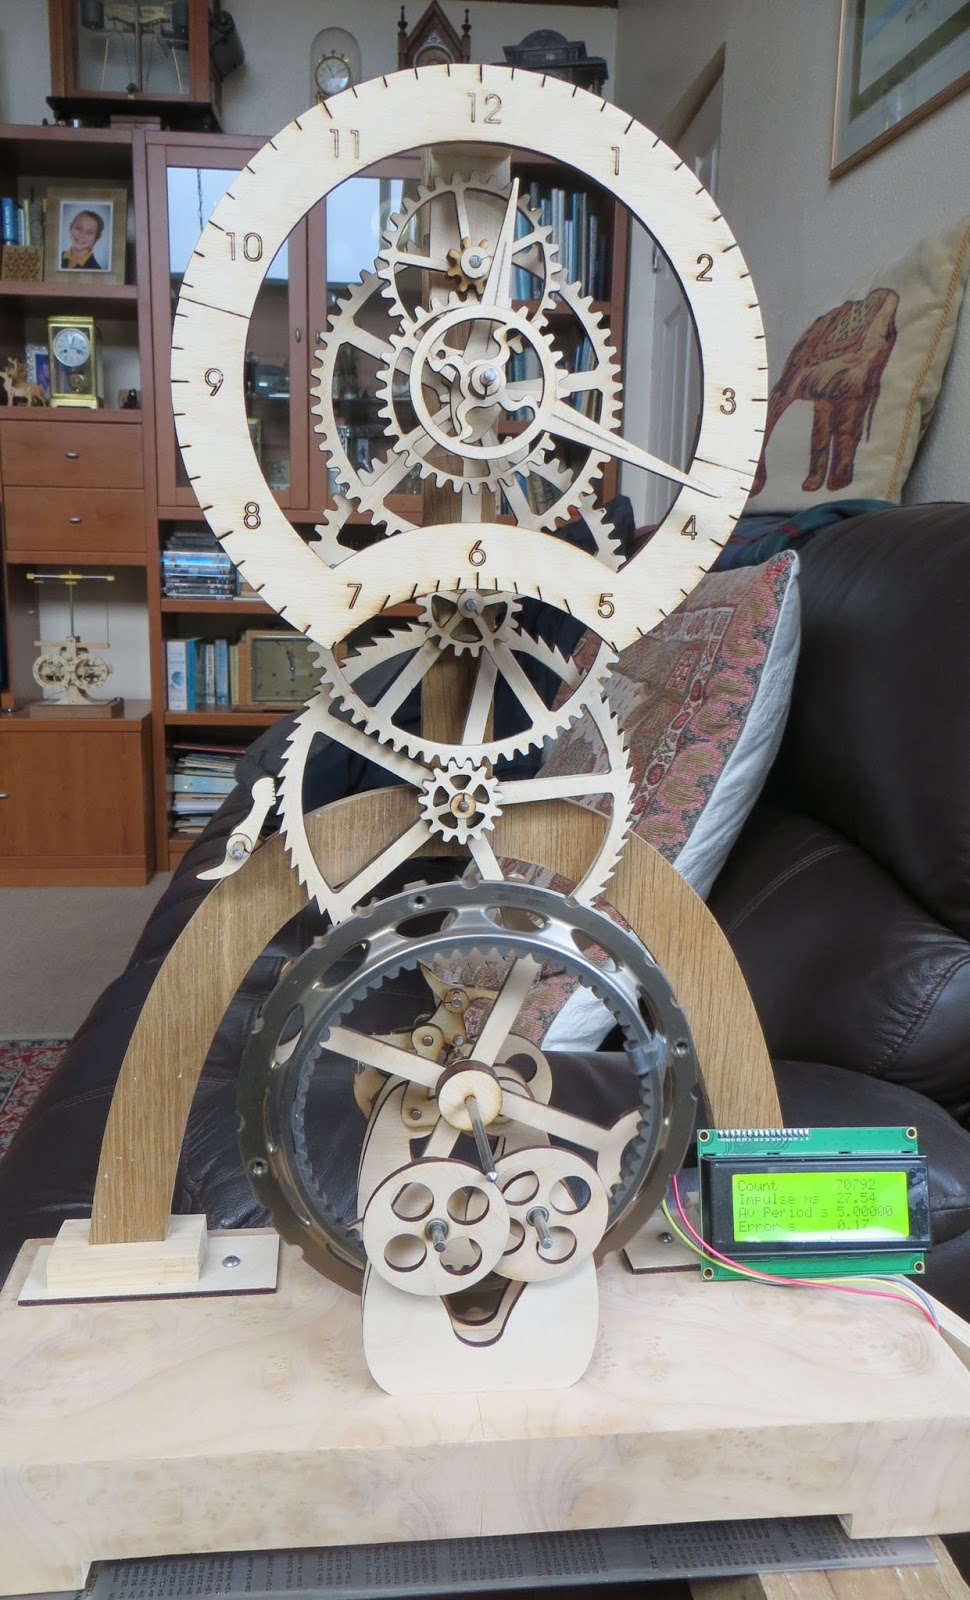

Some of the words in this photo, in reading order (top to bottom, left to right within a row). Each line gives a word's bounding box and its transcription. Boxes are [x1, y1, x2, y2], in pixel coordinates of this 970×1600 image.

[466, 92, 502, 124] 12
[329, 128, 360, 159] 11
[610, 146, 620, 176] 1
[225, 231, 264, 263] 10
[695, 253, 713, 282] 2
[204, 367, 224, 396] 9
[719, 387, 737, 415] 3
[243, 501, 262, 530] 8
[679, 514, 698, 540] 4
[467, 539, 487, 567] 6
[346, 583, 363, 610] 7
[597, 592, 615, 619] 5
[737, 1180, 778, 1192] Count
[836, 1179, 876, 1191] 70792
[739, 1193, 796, 1206] Impulse
[803, 1195, 820, 1205] ms
[836, 1192, 876, 1204] 27.54
[738, 1207, 755, 1218] Av
[763, 1206, 813, 1218] Period
[836, 1205, 894, 1217] 5.00000
[738, 1220, 780, 1232] Error
